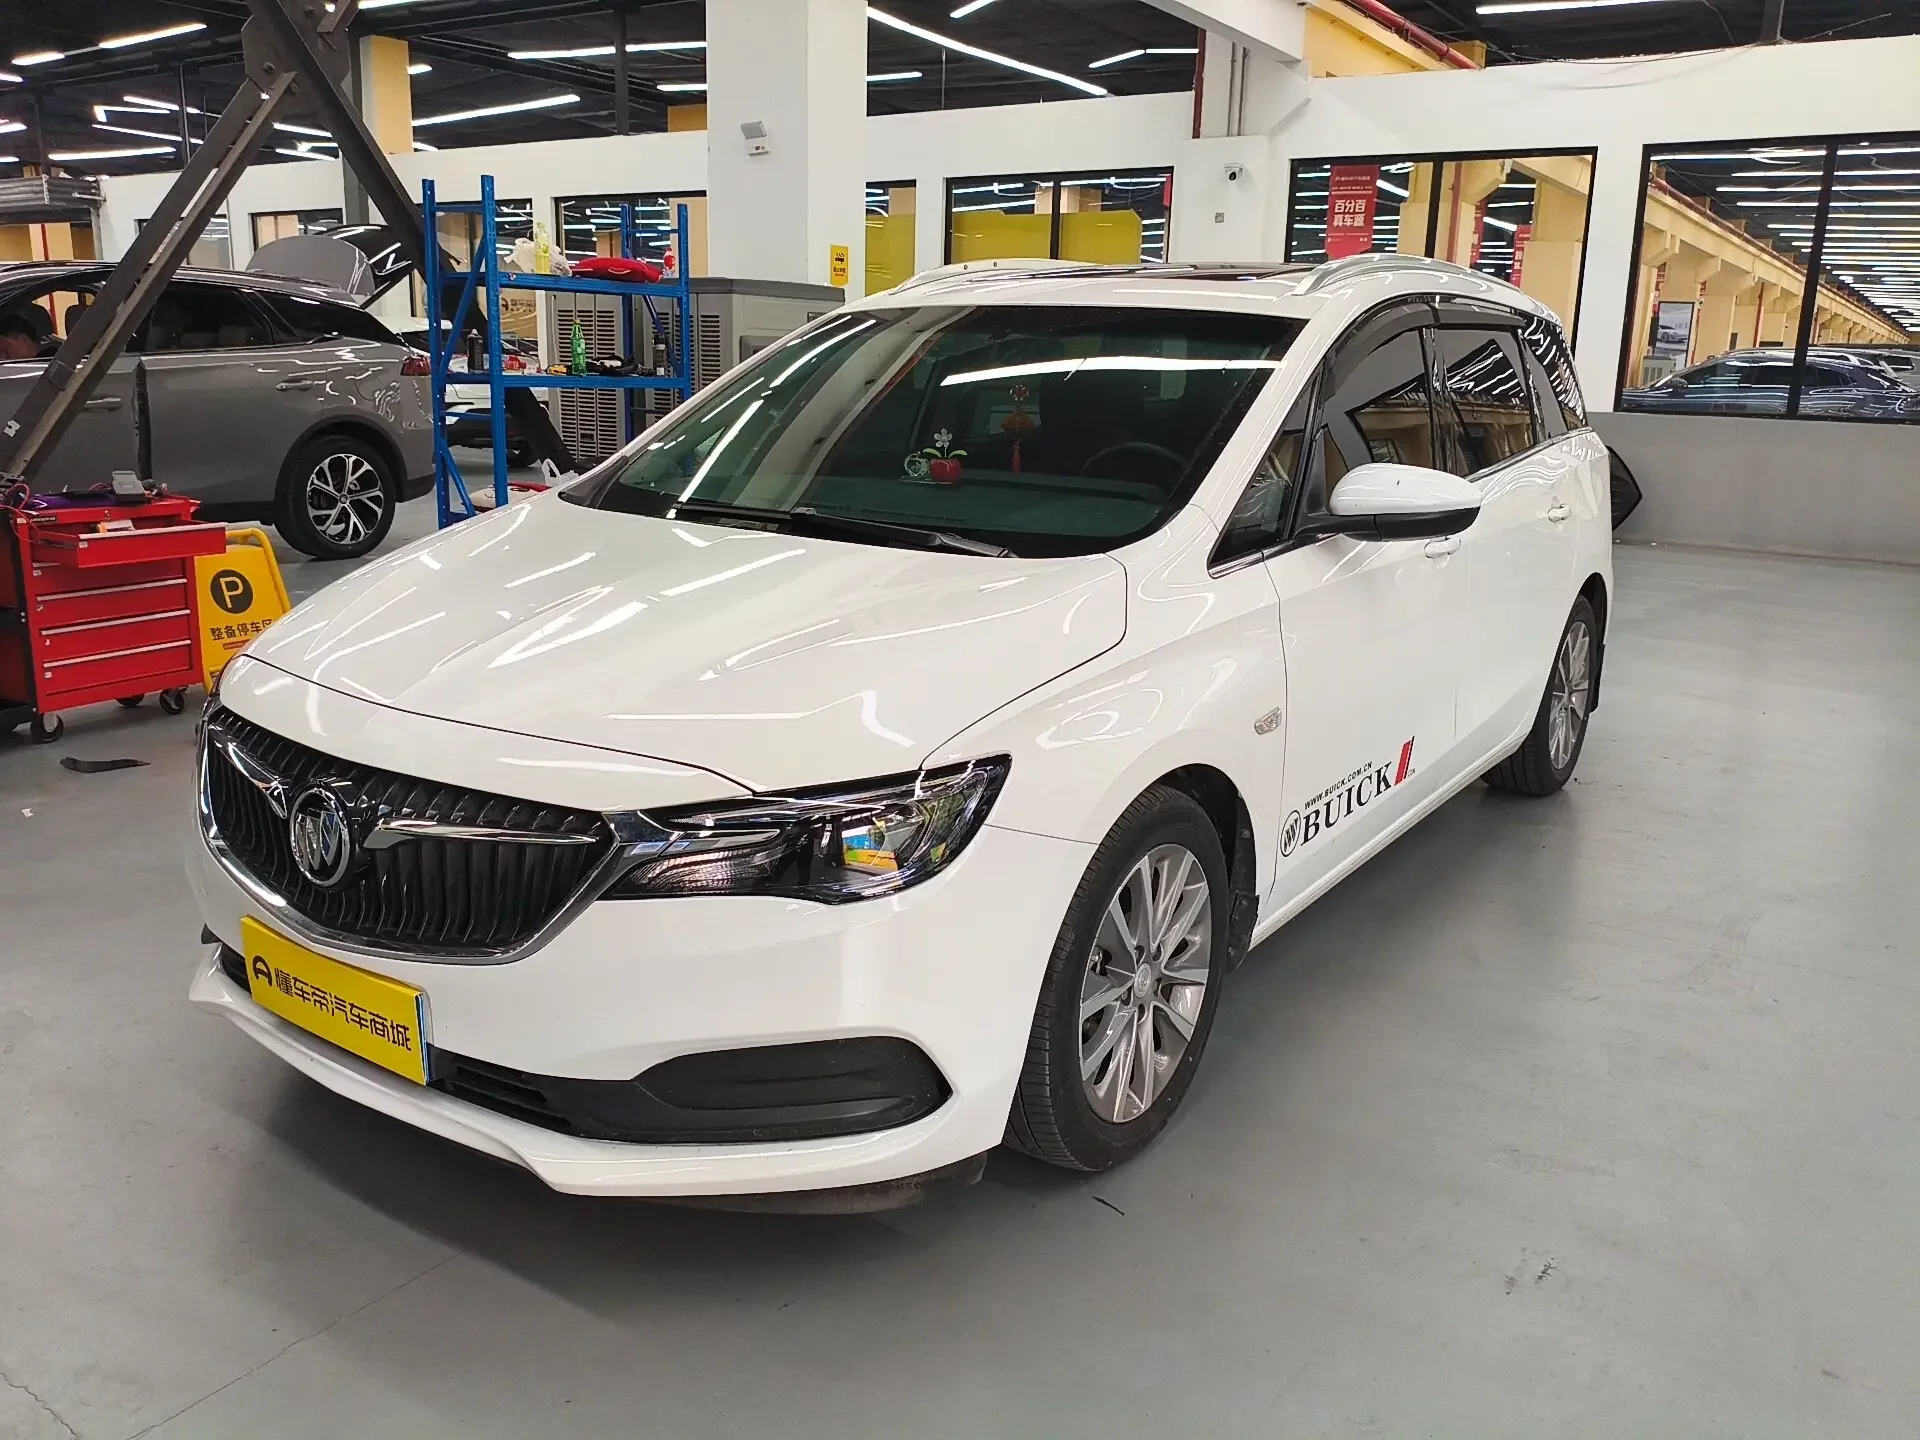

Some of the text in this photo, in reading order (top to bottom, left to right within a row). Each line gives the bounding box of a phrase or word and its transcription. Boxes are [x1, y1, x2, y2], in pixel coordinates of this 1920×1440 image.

[1335, 199, 1367, 212] 百分百
[220, 577, 243, 608] P
[1300, 761, 1392, 846] BUICK
[1304, 761, 1372, 810] WWW.BUICK.COM.CN
[274, 967, 412, 1051] 懂车帝汽车商城
